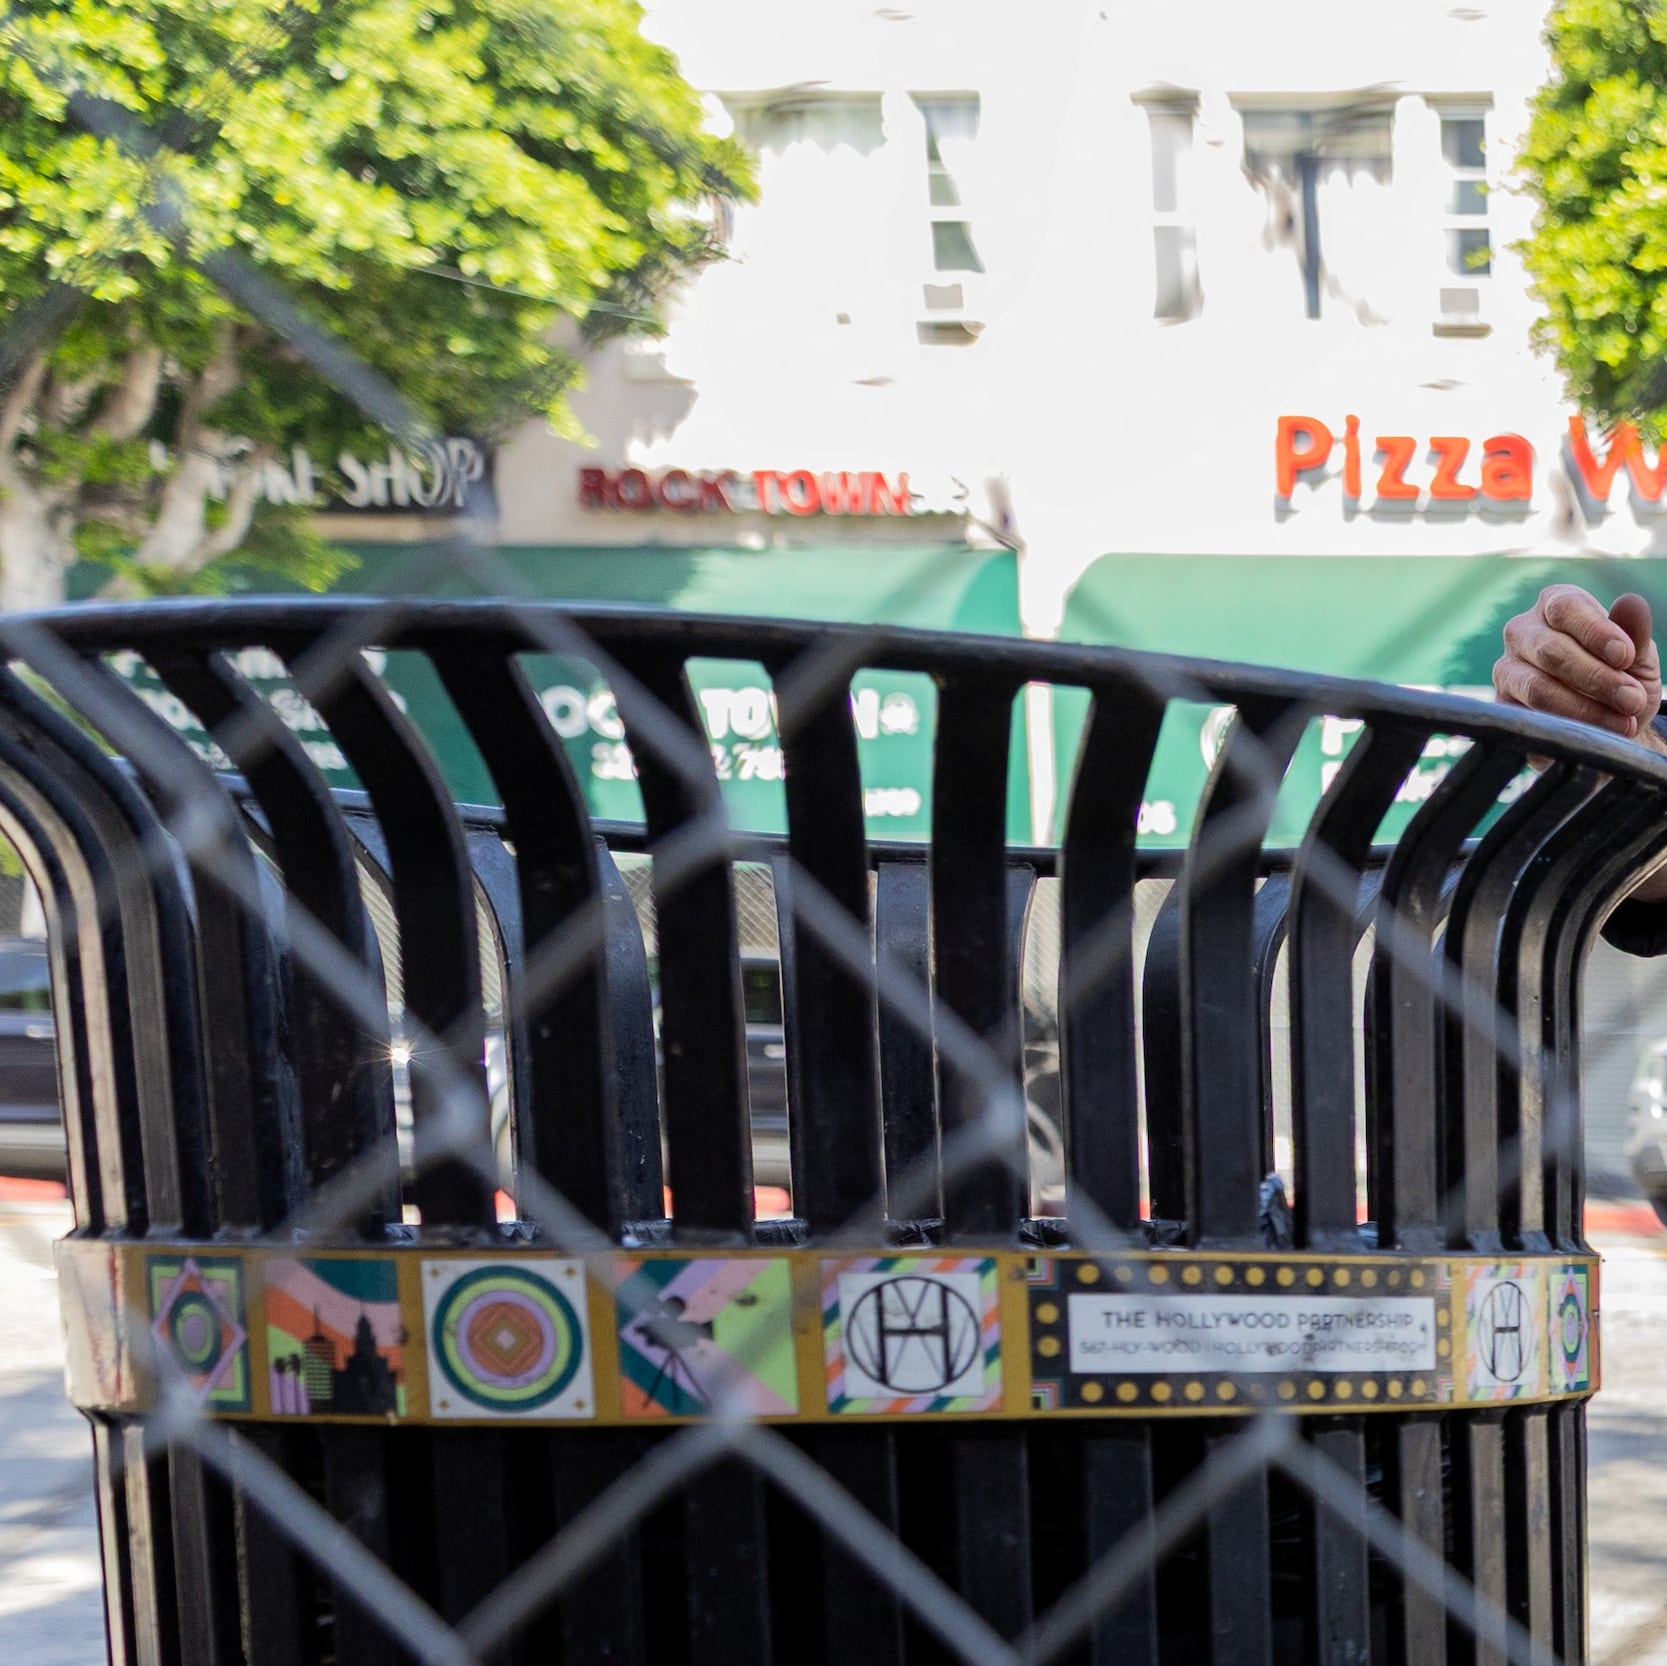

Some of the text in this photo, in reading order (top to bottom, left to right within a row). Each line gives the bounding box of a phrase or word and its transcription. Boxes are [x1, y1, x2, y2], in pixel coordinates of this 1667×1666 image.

[1275, 414, 1534, 500] Pizza
[577, 467, 740, 515] ROCK
[751, 468, 912, 517] TOWN
[1103, 1311, 1415, 1331] THE HOLLYWOOD PARTNERSHIP
